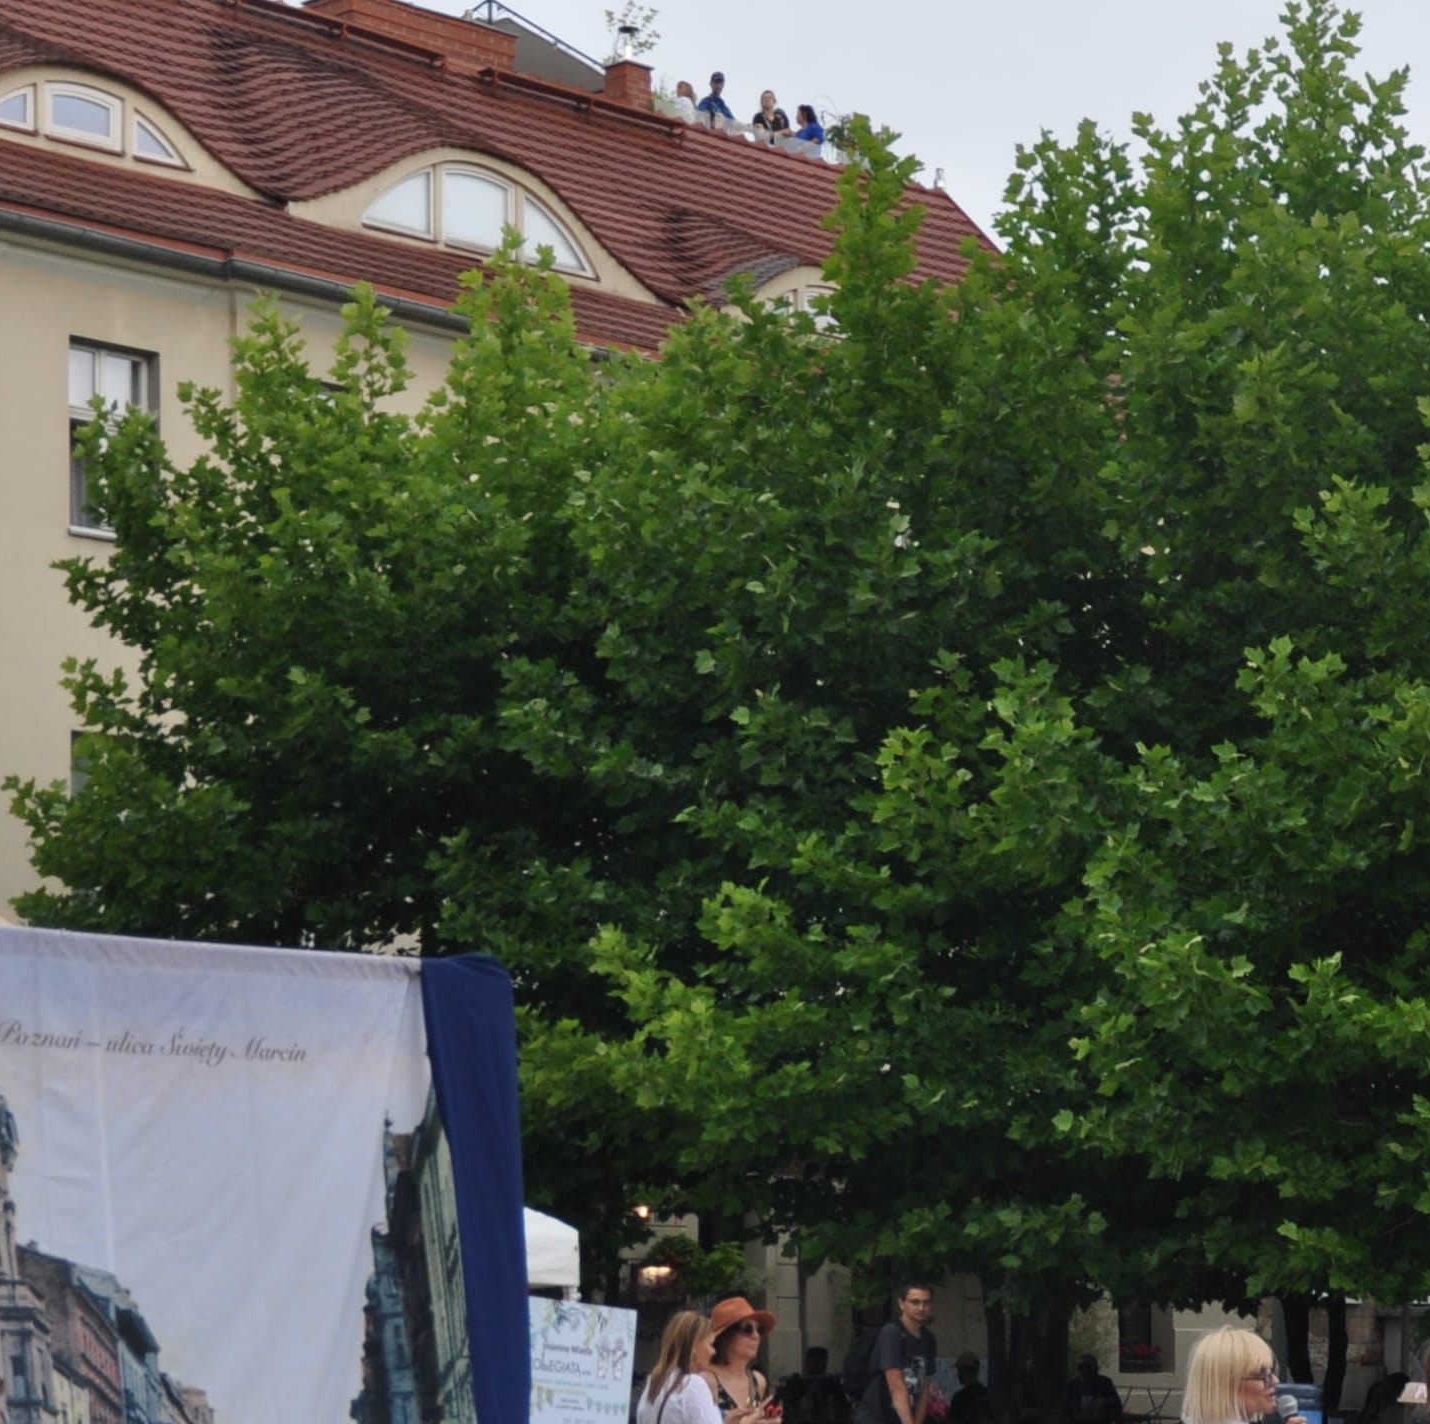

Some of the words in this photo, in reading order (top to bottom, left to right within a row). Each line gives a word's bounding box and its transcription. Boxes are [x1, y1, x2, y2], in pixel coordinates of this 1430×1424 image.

[106, 1031, 153, 1056] ulica
[159, 1026, 228, 1067] Święty
[230, 1036, 307, 1063] Marcin
